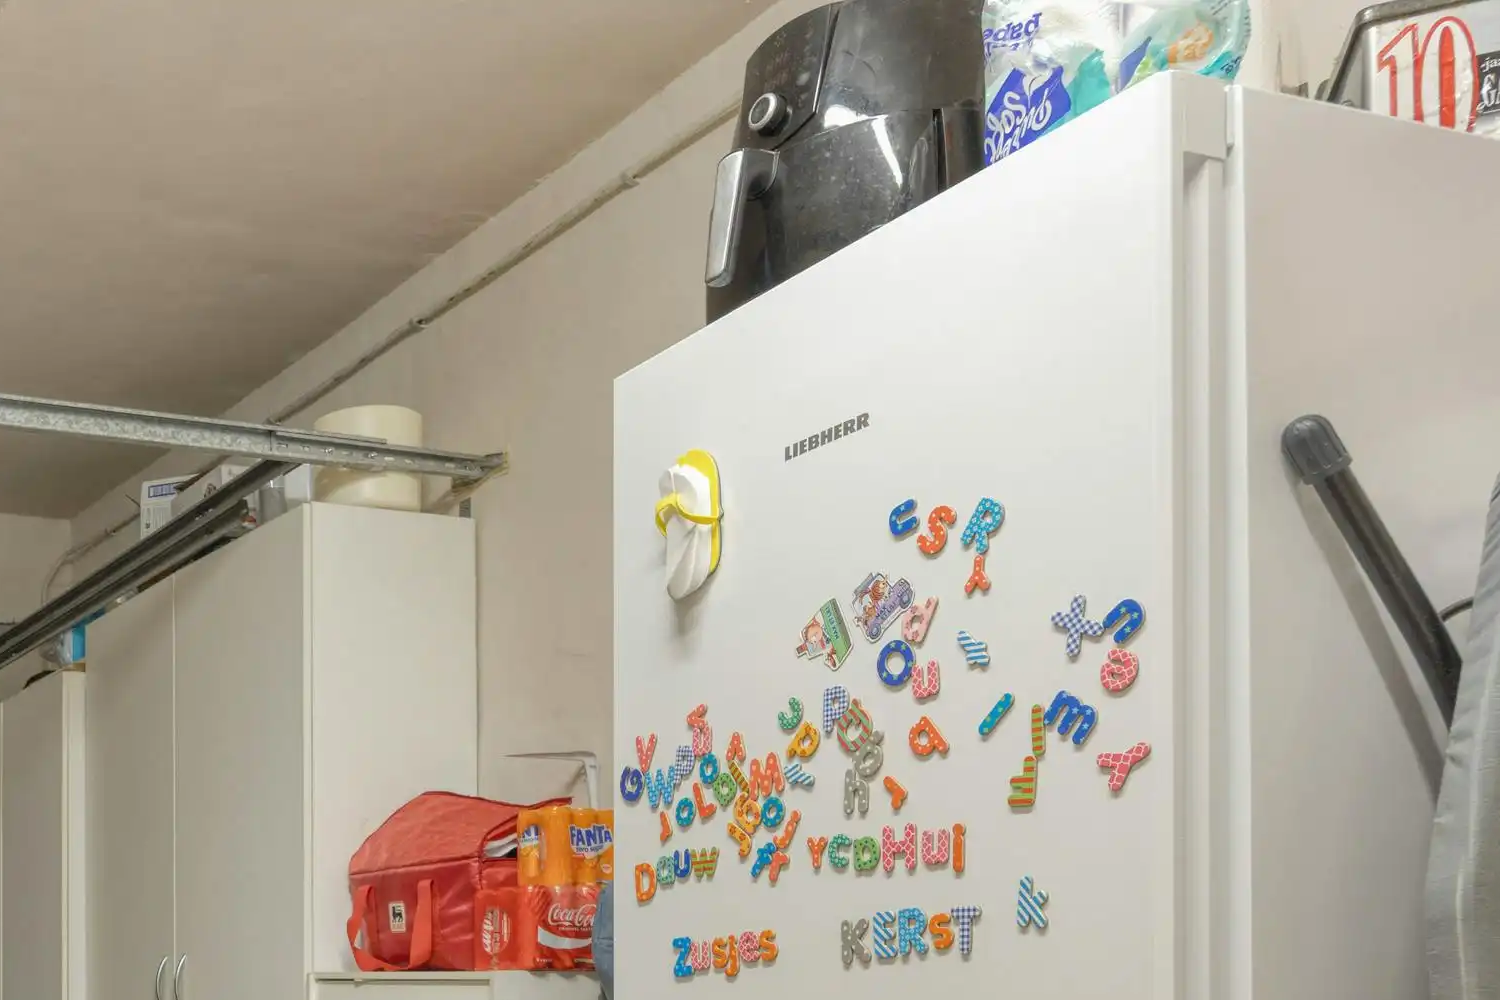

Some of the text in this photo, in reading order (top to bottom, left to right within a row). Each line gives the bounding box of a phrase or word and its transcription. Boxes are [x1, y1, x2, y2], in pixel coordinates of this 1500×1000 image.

[1377, 16, 1480, 133] 10
[785, 412, 869, 462] LIEBHERR
[570, 825, 613, 847] FANTA
[672, 930, 780, 977] Zusjes
